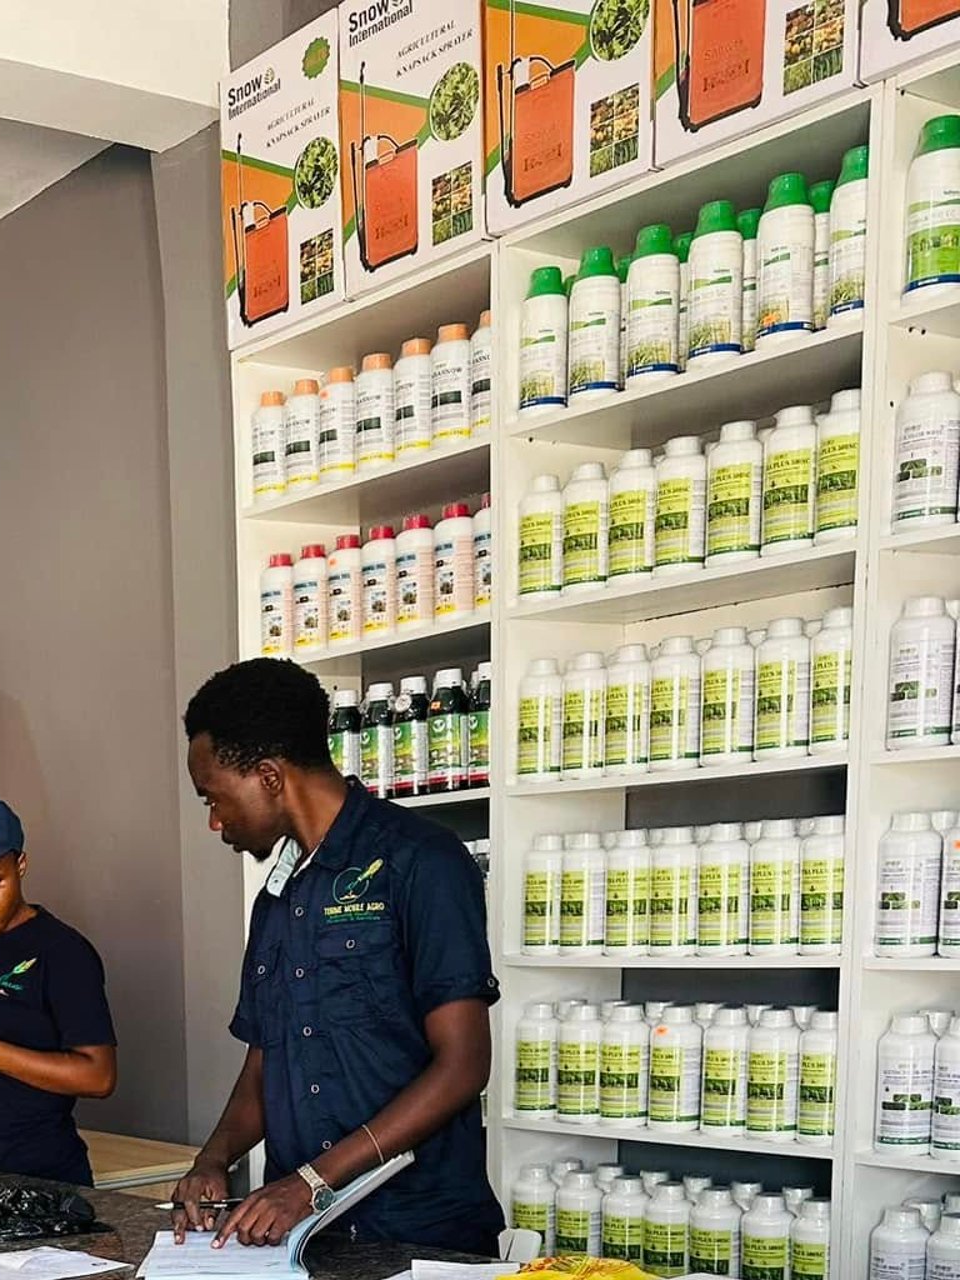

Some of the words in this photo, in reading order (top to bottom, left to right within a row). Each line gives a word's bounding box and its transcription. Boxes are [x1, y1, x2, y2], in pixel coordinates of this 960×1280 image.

[349, 0, 389, 32] Snow
[349, 0, 412, 48] International
[228, 74, 262, 106] Snow
[228, 78, 281, 120] International
